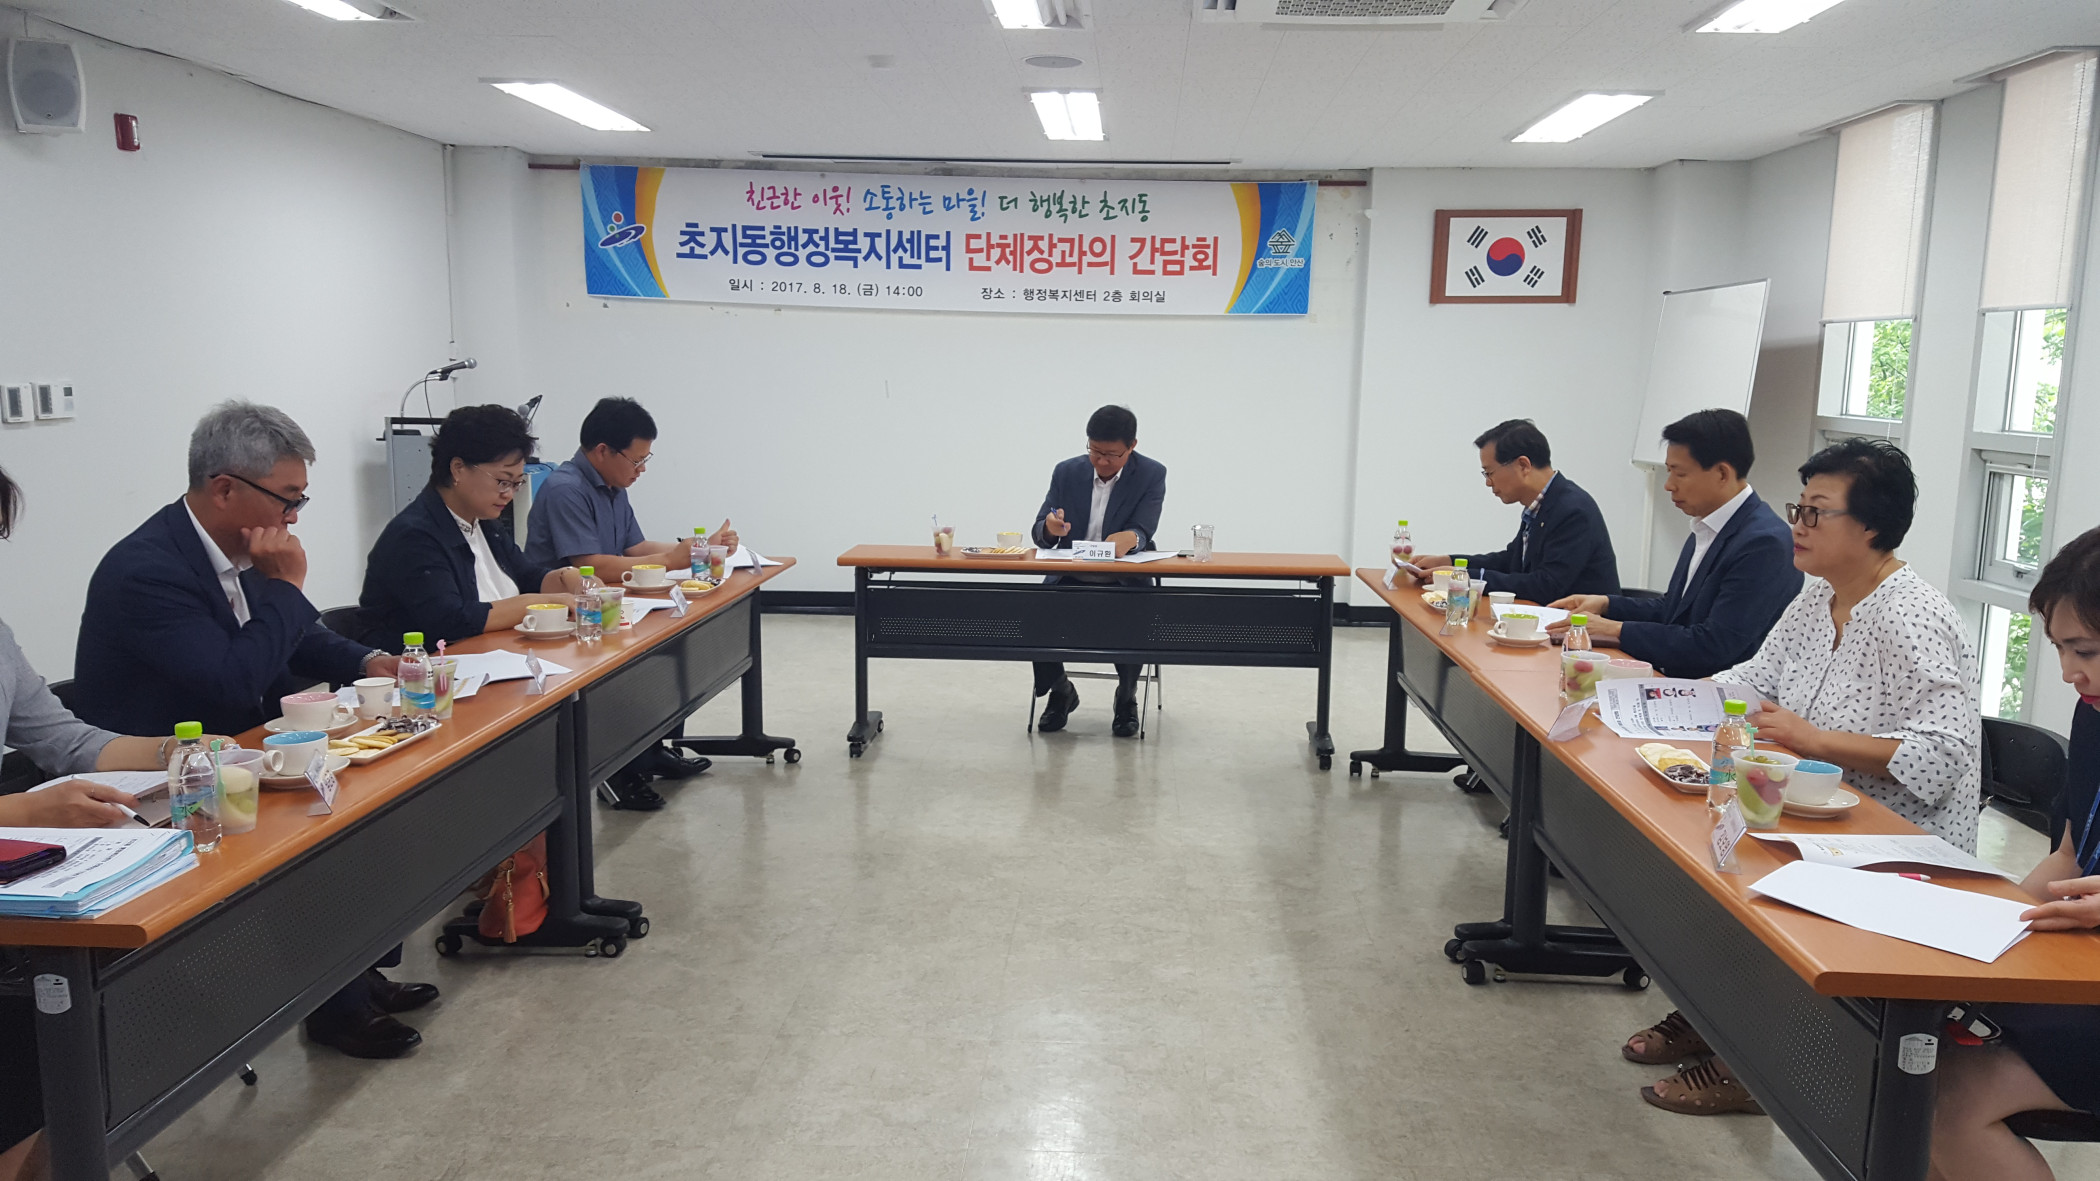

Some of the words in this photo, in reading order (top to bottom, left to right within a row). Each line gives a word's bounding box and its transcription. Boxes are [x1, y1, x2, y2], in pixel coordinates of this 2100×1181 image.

[746, 181, 803, 211] 친근한
[811, 184, 852, 216] 이웃!
[862, 184, 934, 221] 소통하는
[942, 187, 987, 222] 마을!
[998, 194, 1019, 212] 더
[1028, 189, 1091, 224] 행복한
[1099, 190, 1151, 223] 초지동
[675, 222, 952, 272] 초지동행정복지센터
[964, 231, 1117, 276] 단체장과의
[1127, 234, 1220, 277] 간담회
[1273, 258, 1289, 267] 도시
[728, 278, 753, 292] 일시
[771, 280, 807, 294] 2017.
[812, 282, 826, 295] 8.
[831, 283, 851, 296] 18.
[856, 282, 880, 298] (금)
[885, 284, 924, 298] 14:00
[980, 287, 1006, 300] 장소
[1022, 287, 1097, 303] 행정복지센터
[1102, 290, 1123, 303] 2층
[1128, 289, 1166, 303] 회의실
